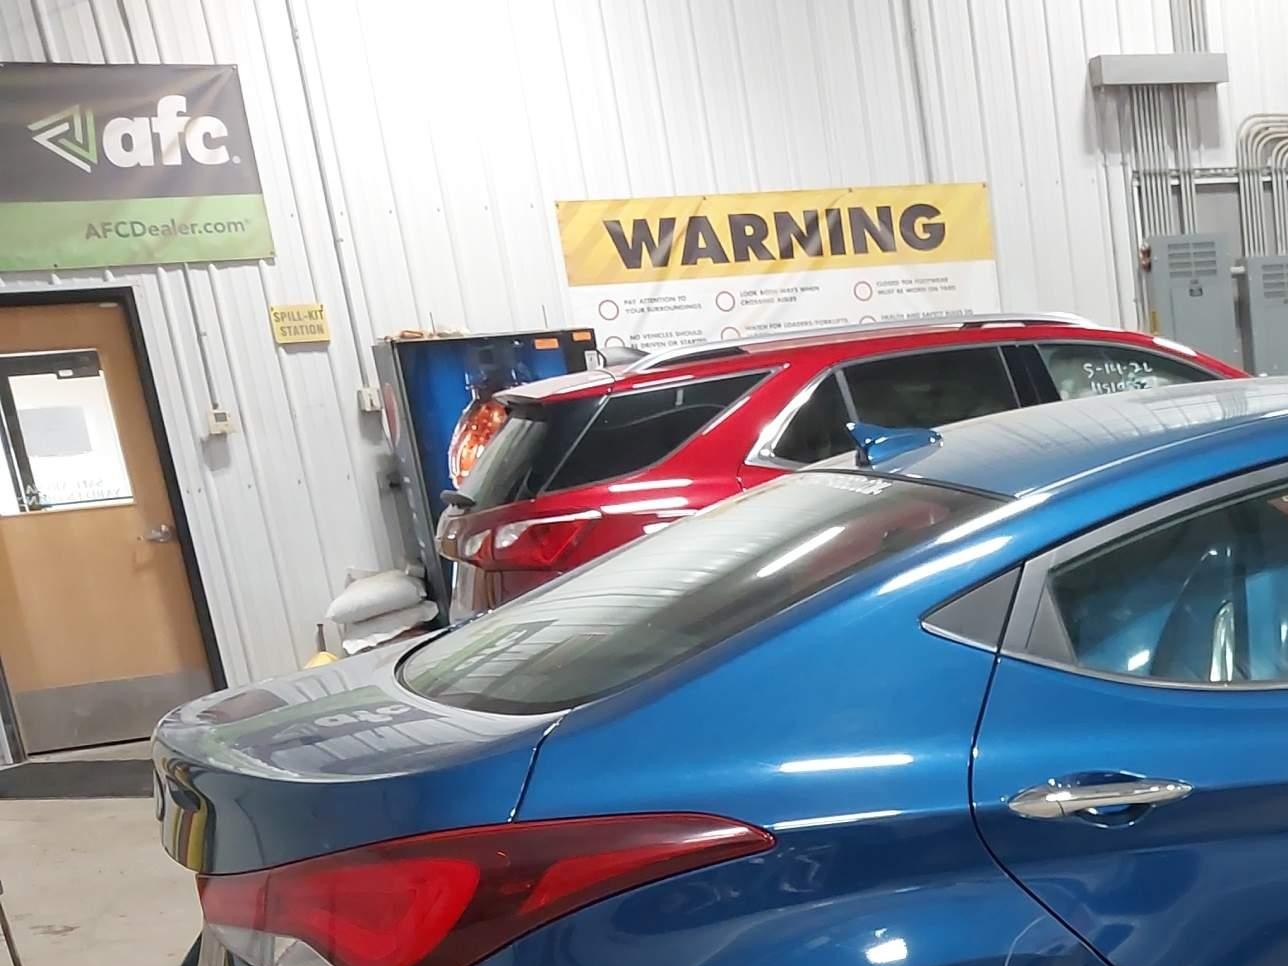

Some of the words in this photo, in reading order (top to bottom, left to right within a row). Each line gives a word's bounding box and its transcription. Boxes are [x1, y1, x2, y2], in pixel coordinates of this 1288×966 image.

[85, 219, 245, 240] AFCDealer.com
[603, 203, 946, 270] WARNING
[639, 296, 676, 304] ATTENTION
[625, 306, 645, 314] YOUR
[646, 303, 703, 313] SURROUNDINGS
[273, 310, 324, 322] SPILL-KIT
[280, 324, 324, 337] STATION
[643, 331, 674, 340] VEHICLES
[675, 329, 703, 338] SHOULD
[640, 340, 667, 349] DRIVEN
